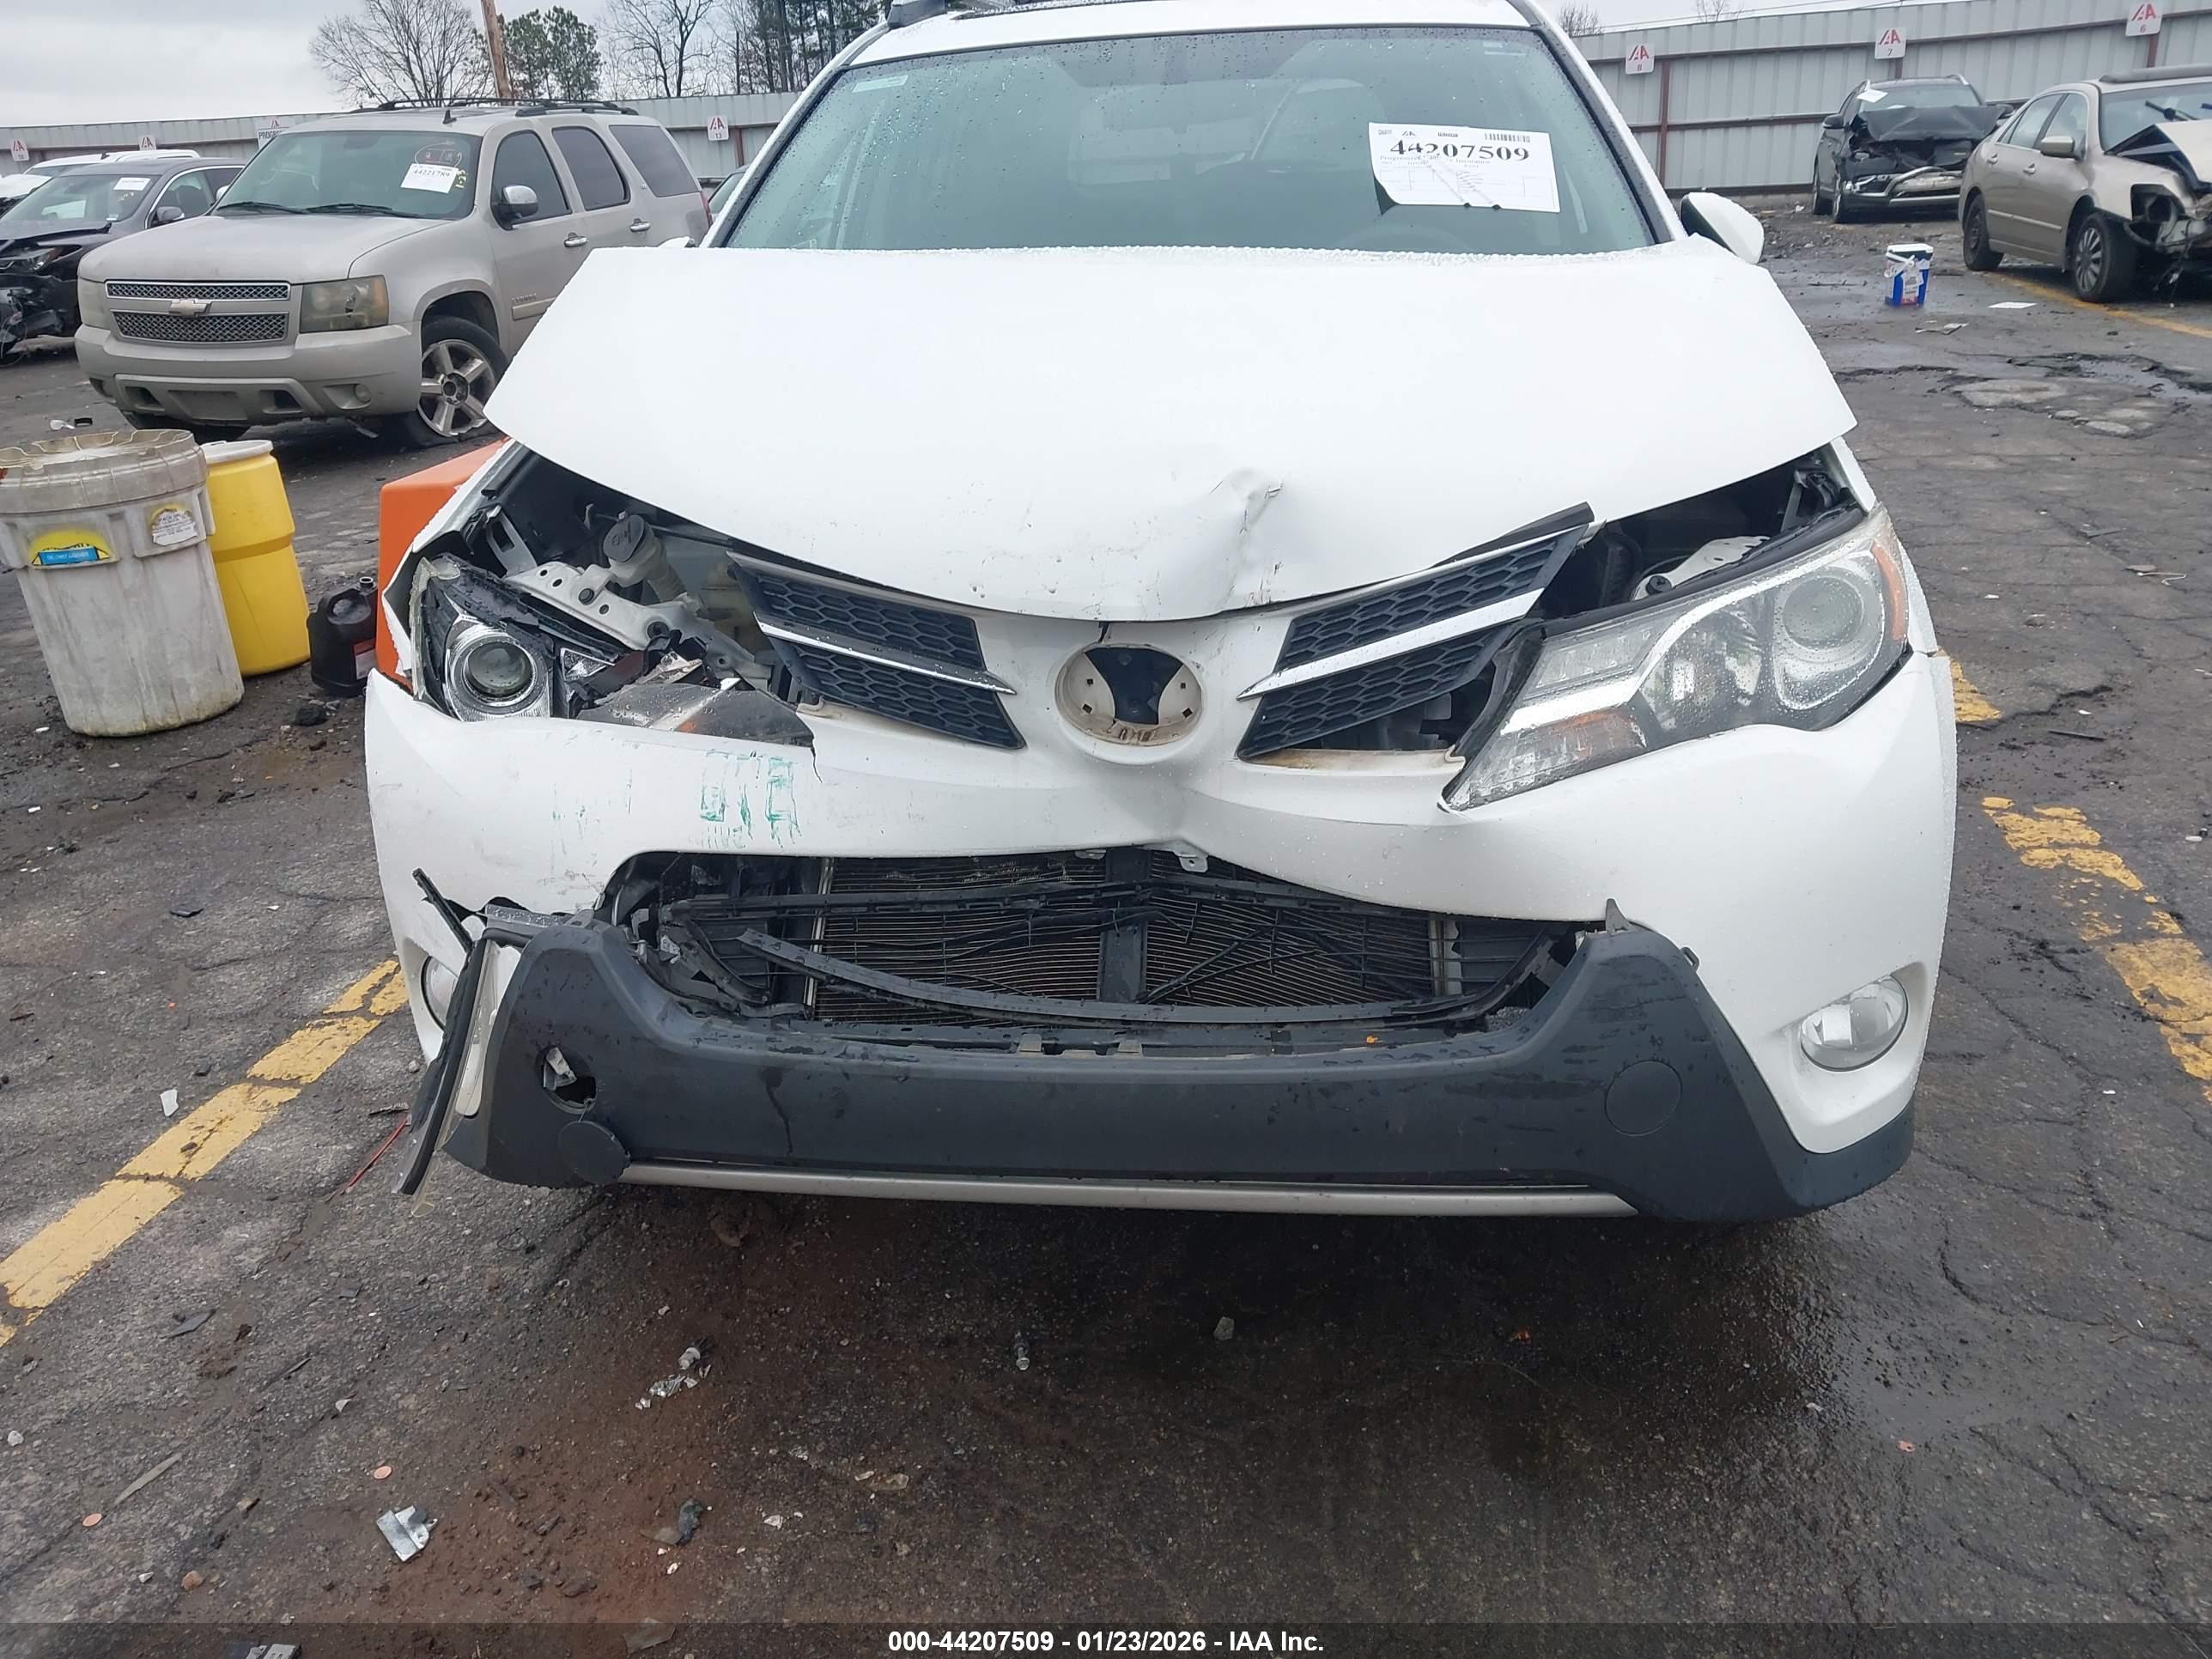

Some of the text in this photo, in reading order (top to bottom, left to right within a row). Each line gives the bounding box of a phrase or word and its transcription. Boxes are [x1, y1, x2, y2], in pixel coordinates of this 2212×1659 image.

[2140, 24, 2147, 33] 6
[1887, 48, 1893, 57] 7
[1389, 139, 1529, 161] 44207509
